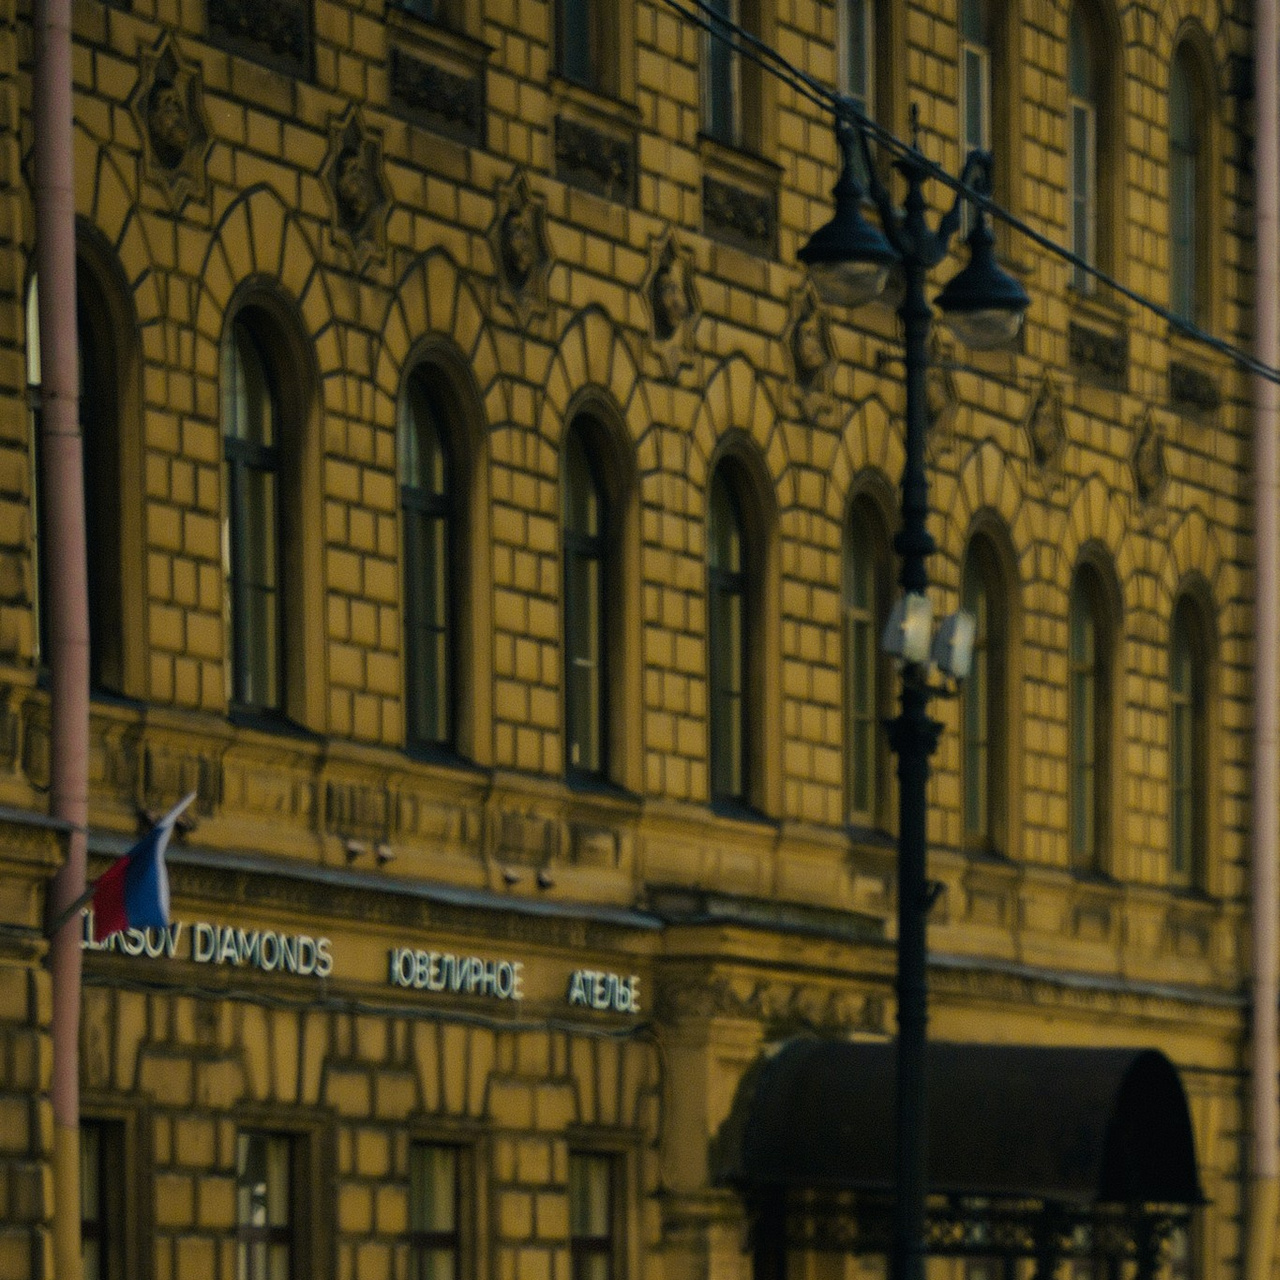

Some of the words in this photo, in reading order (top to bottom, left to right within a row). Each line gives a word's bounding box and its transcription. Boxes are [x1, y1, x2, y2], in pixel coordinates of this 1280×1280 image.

[192, 921, 334, 978] DIAMONDS
[390, 947, 525, 1000] ЮВЕЛИРНОЕ
[568, 969, 641, 1014] АТЕЛЬЕ
